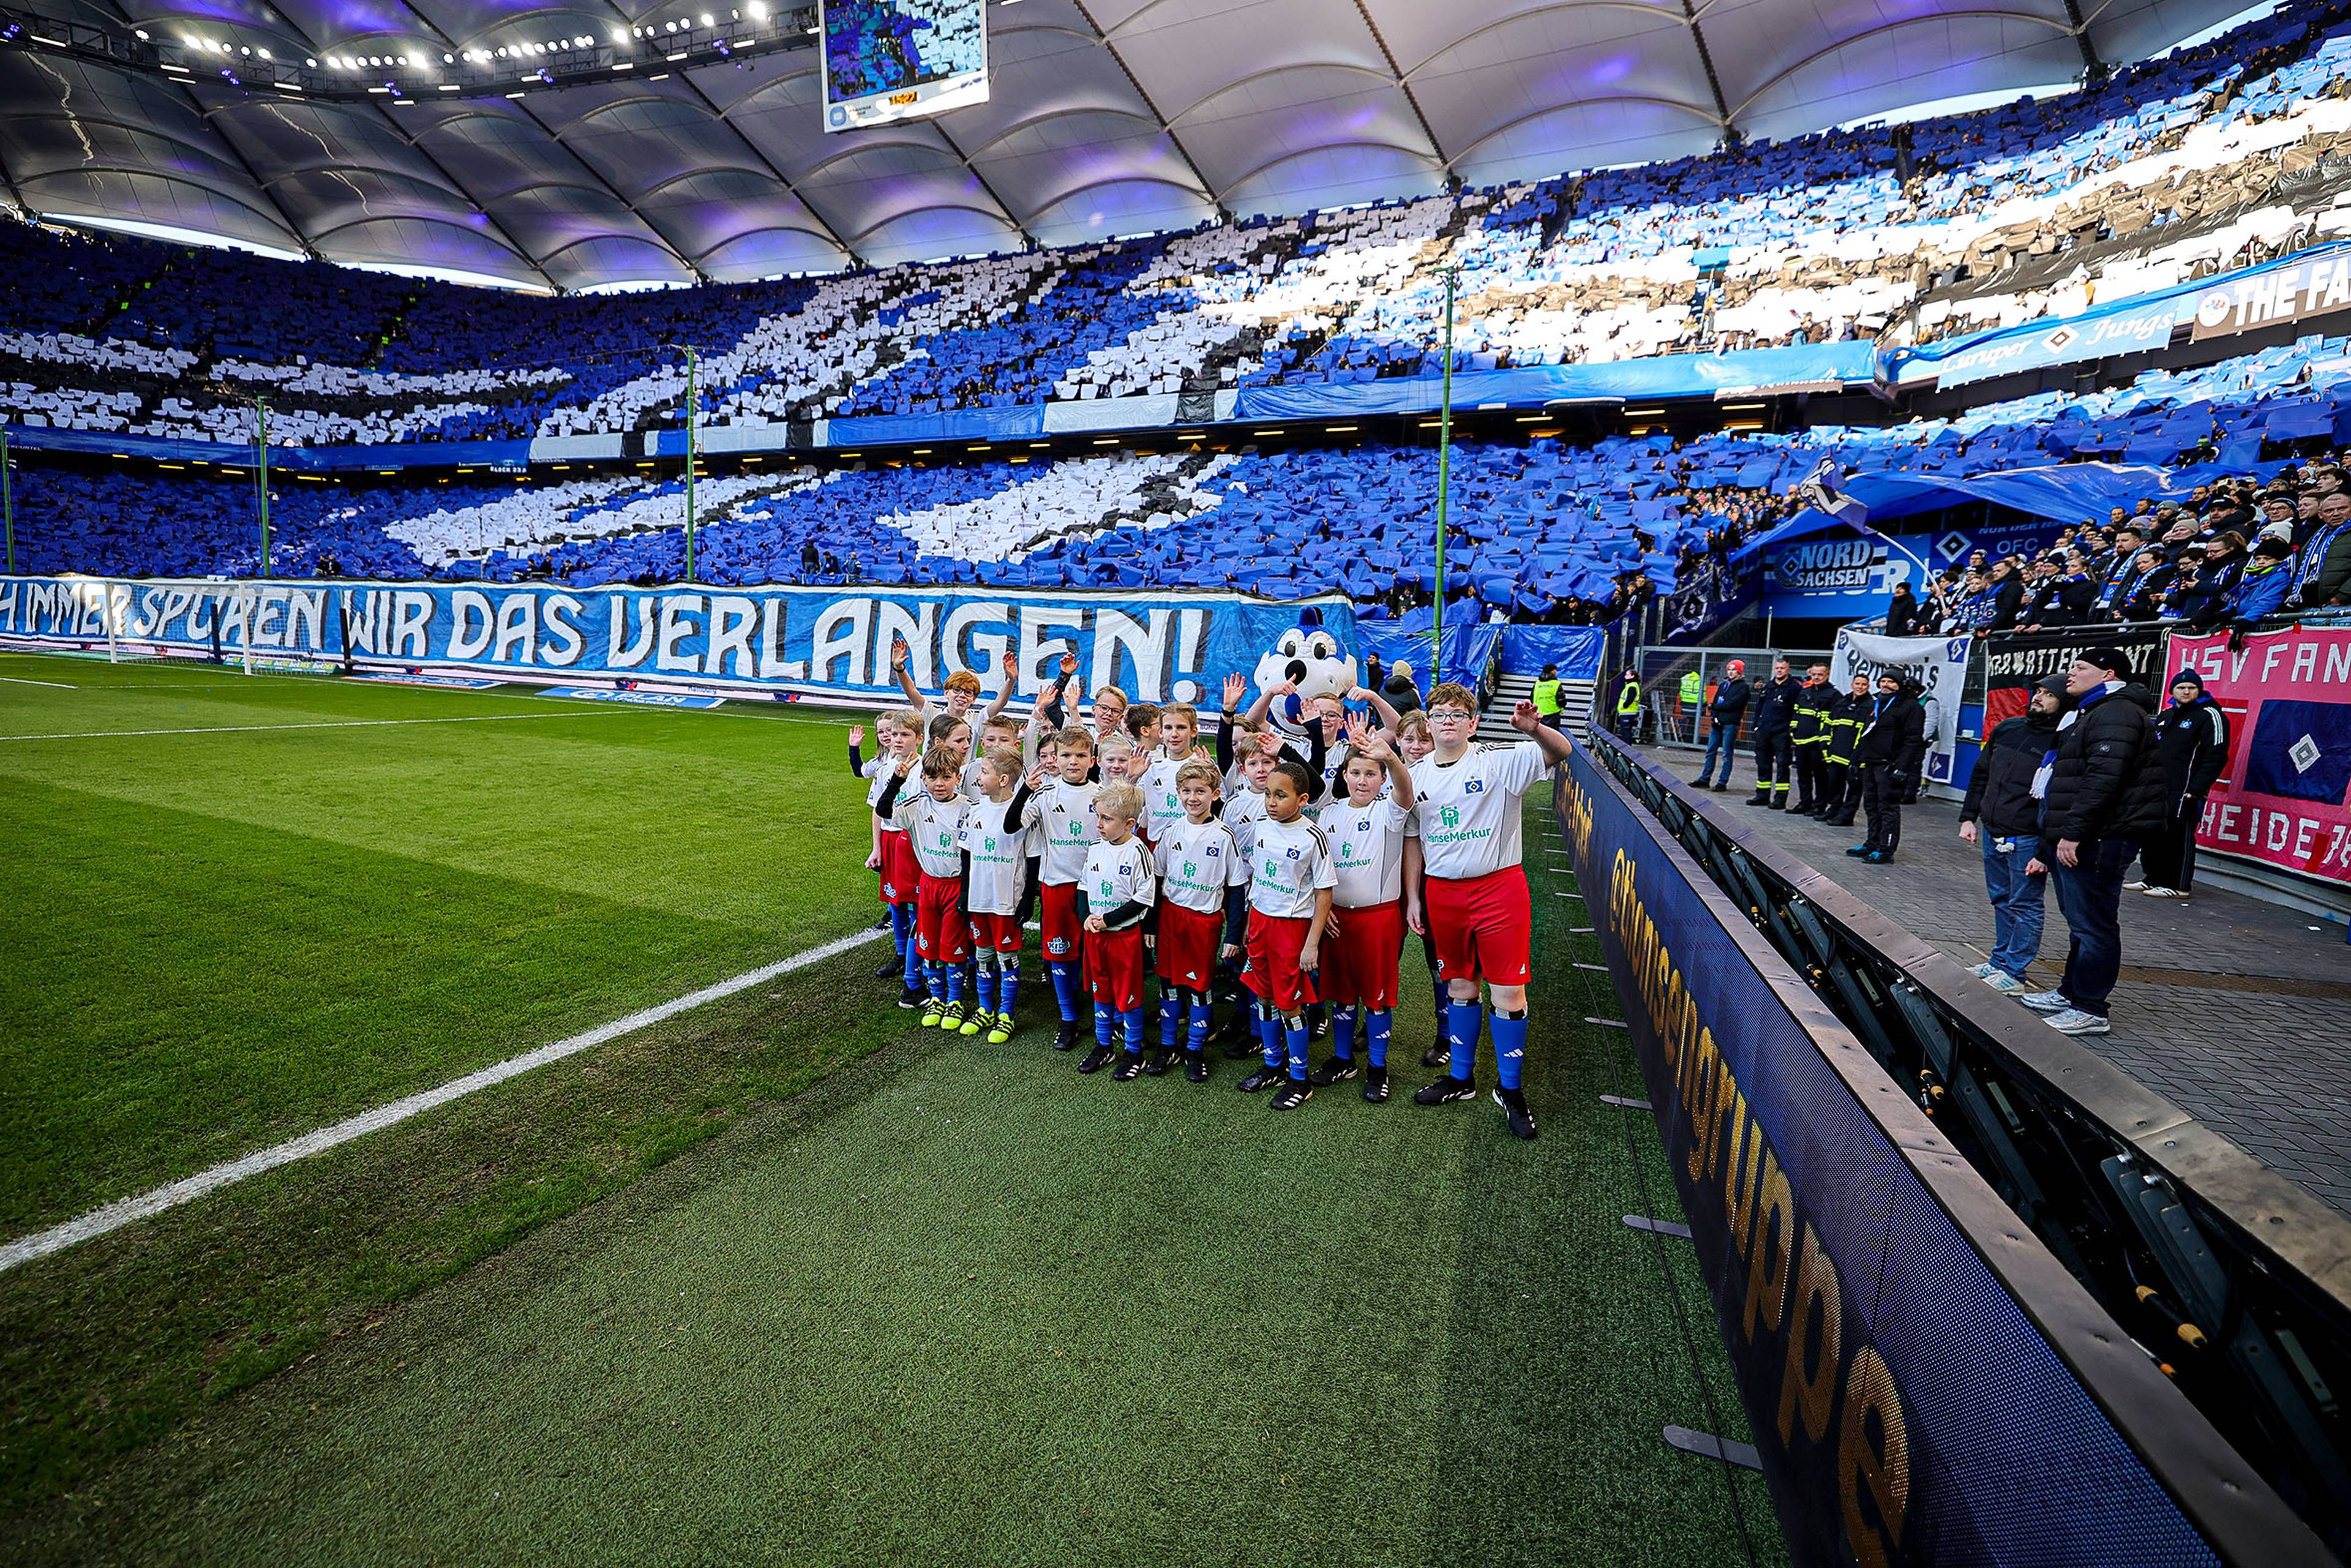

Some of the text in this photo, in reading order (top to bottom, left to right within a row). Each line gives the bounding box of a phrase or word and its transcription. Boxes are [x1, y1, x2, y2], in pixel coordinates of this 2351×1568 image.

[2235, 256, 2351, 327] THE FA
[2086, 312, 2175, 345] Jungs
[1799, 540, 1870, 569] NORD
[1997, 538, 2038, 554] OFC
[1796, 567, 1868, 587] SACHSEN
[344, 589, 432, 658] WIR
[447, 590, 586, 666] DAS
[608, 595, 1204, 704] VERLANGEN!
[2181, 643, 2251, 683] HSV
[1049, 838, 1092, 847] HanseMerk
[1427, 828, 1491, 843] HanseMerkur
[2197, 803, 2320, 860] HEIDE
[973, 855, 1014, 864] anseMerkur
[1610, 847, 1909, 1568] @thomsengruppe
